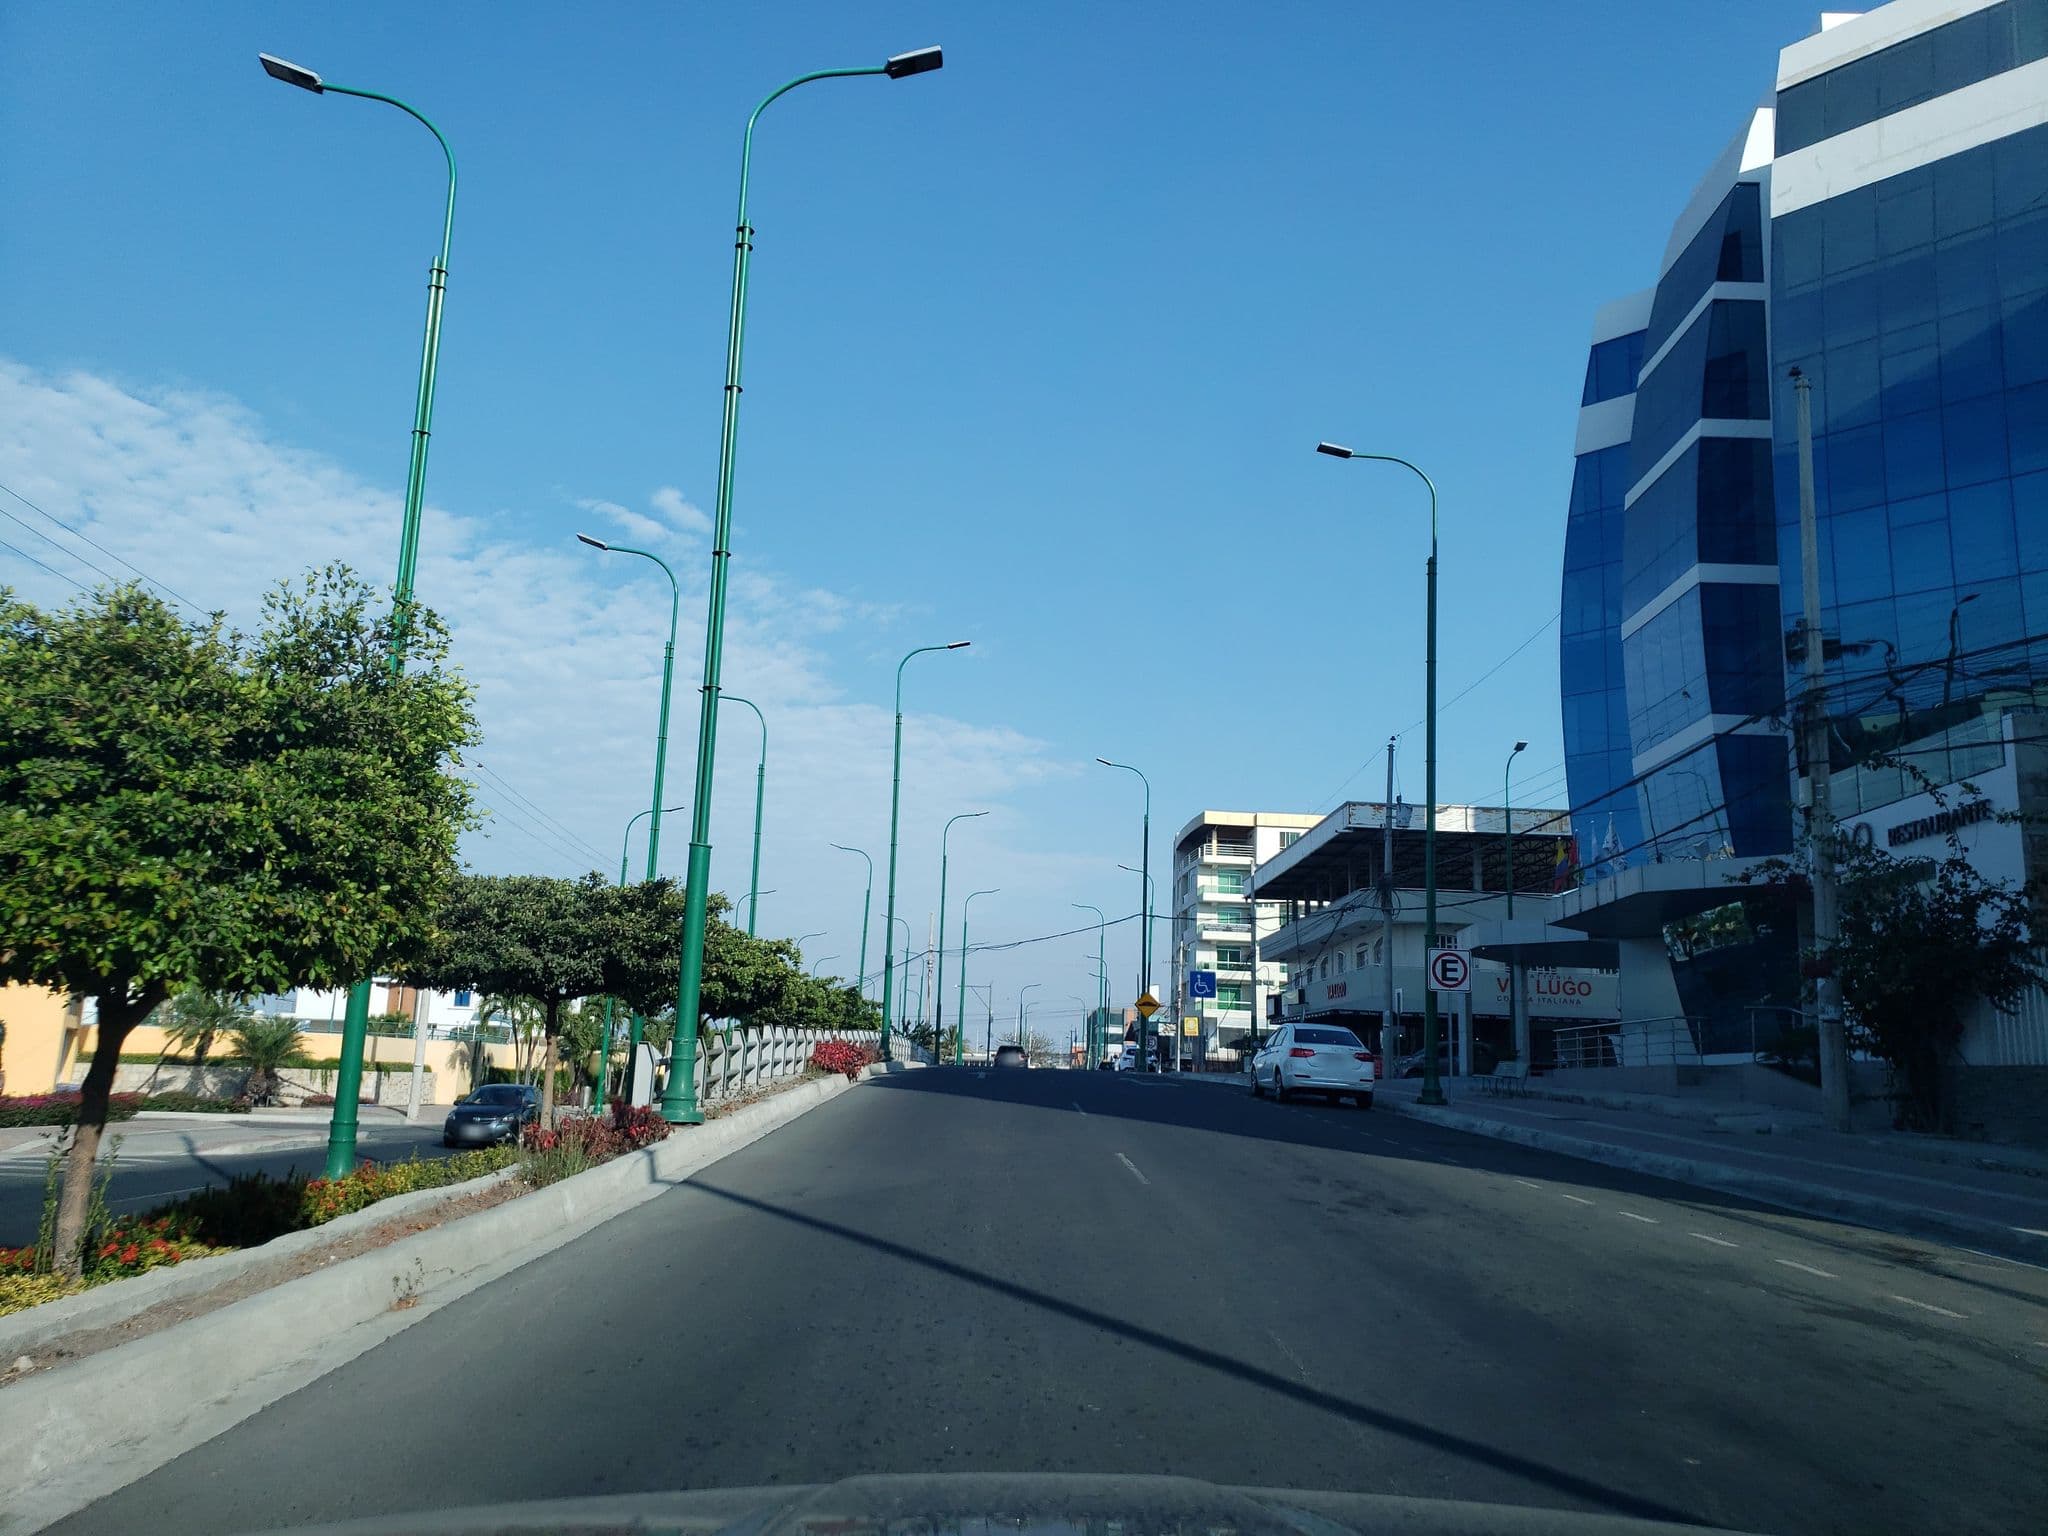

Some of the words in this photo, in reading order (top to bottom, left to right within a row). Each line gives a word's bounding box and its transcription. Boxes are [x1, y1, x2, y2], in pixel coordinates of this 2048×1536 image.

[1887, 798, 1994, 848] RESTAURANTE
[1441, 959, 1459, 982] E
[1536, 981, 1592, 996] LUGO
[1537, 997, 1582, 1006] ITALIANA
